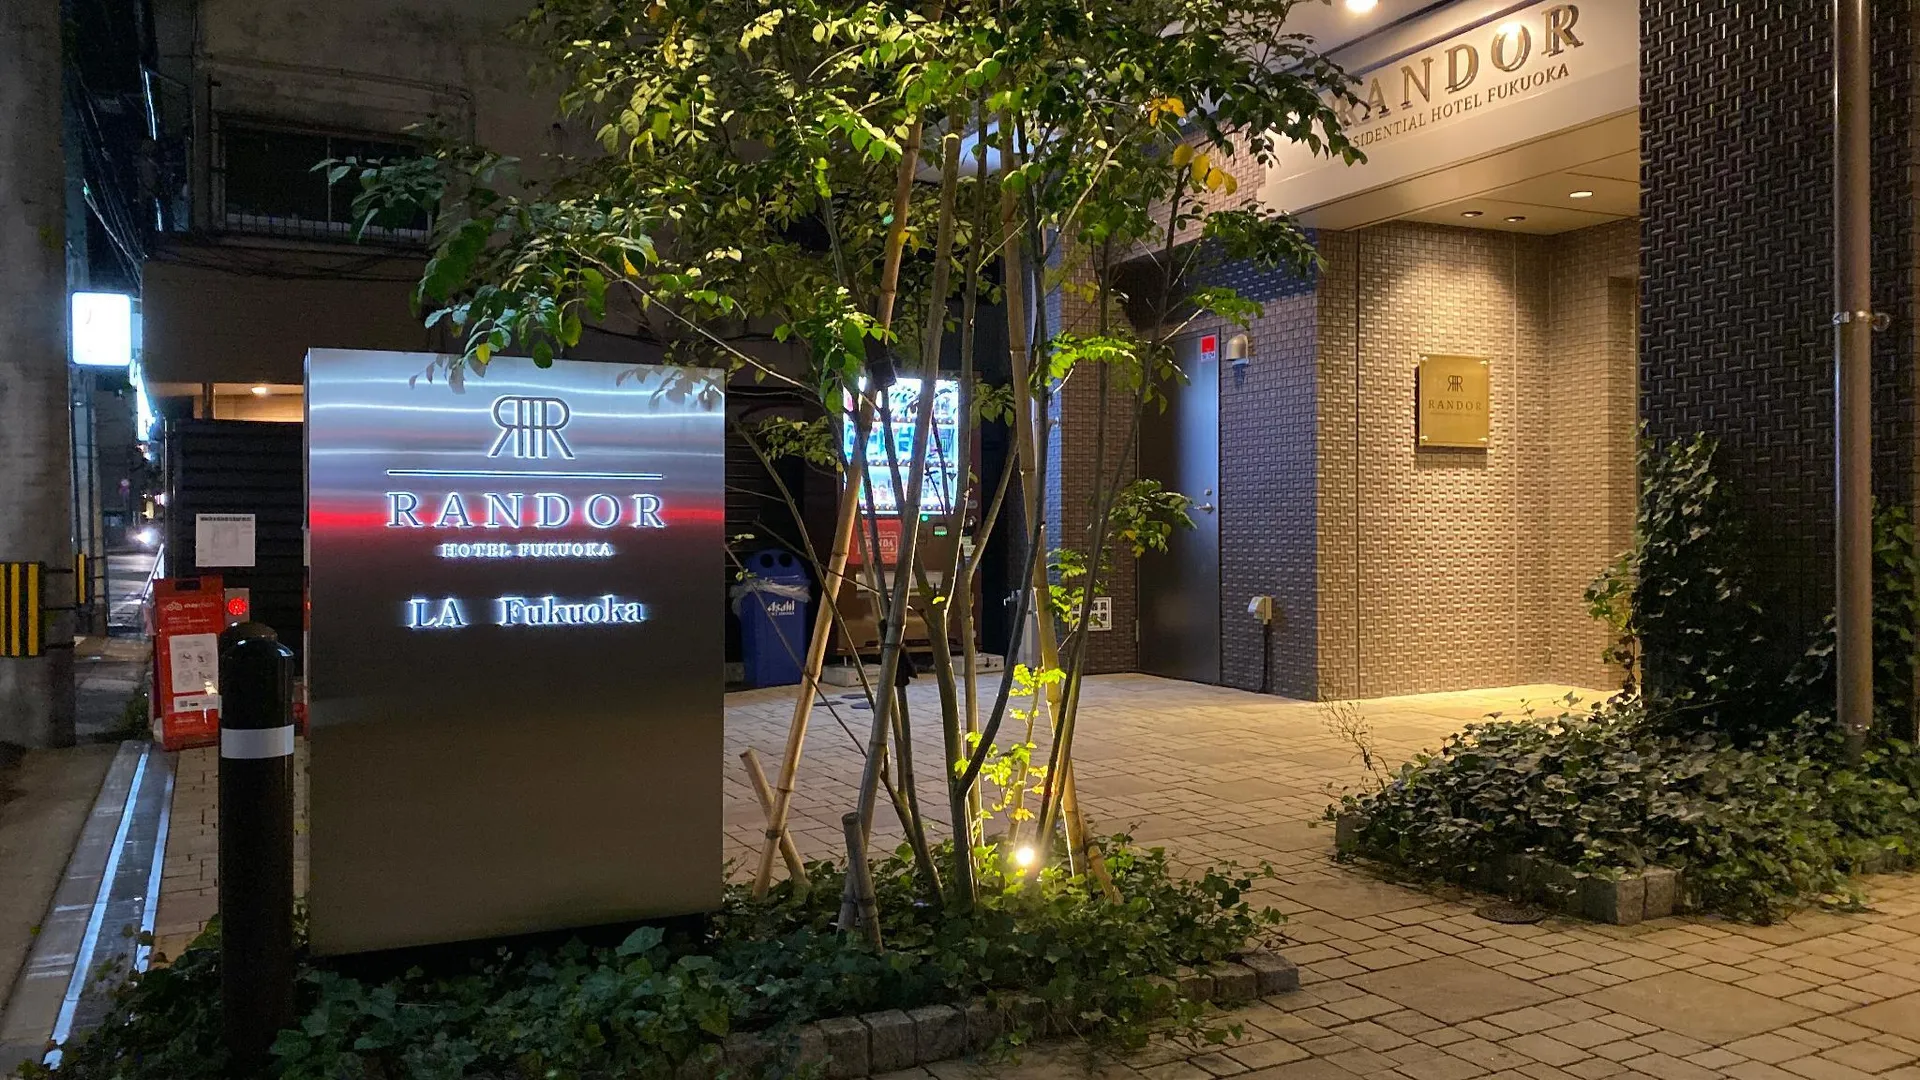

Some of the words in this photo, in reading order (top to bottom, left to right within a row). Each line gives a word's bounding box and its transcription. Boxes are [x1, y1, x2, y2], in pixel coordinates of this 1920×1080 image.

[1348, 113, 1426, 148] SIDENTIAL
[1431, 93, 1482, 122] HOTEL
[1488, 63, 1569, 103] FUKUOKA
[1428, 399, 1482, 411] RANDOR
[386, 491, 665, 528] RANDOR
[441, 543, 512, 558] HOTEL
[517, 542, 614, 557] FUKUOKA
[407, 598, 468, 628] LA
[497, 594, 646, 626] Fukuoka
[767, 600, 795, 612] Asahi
